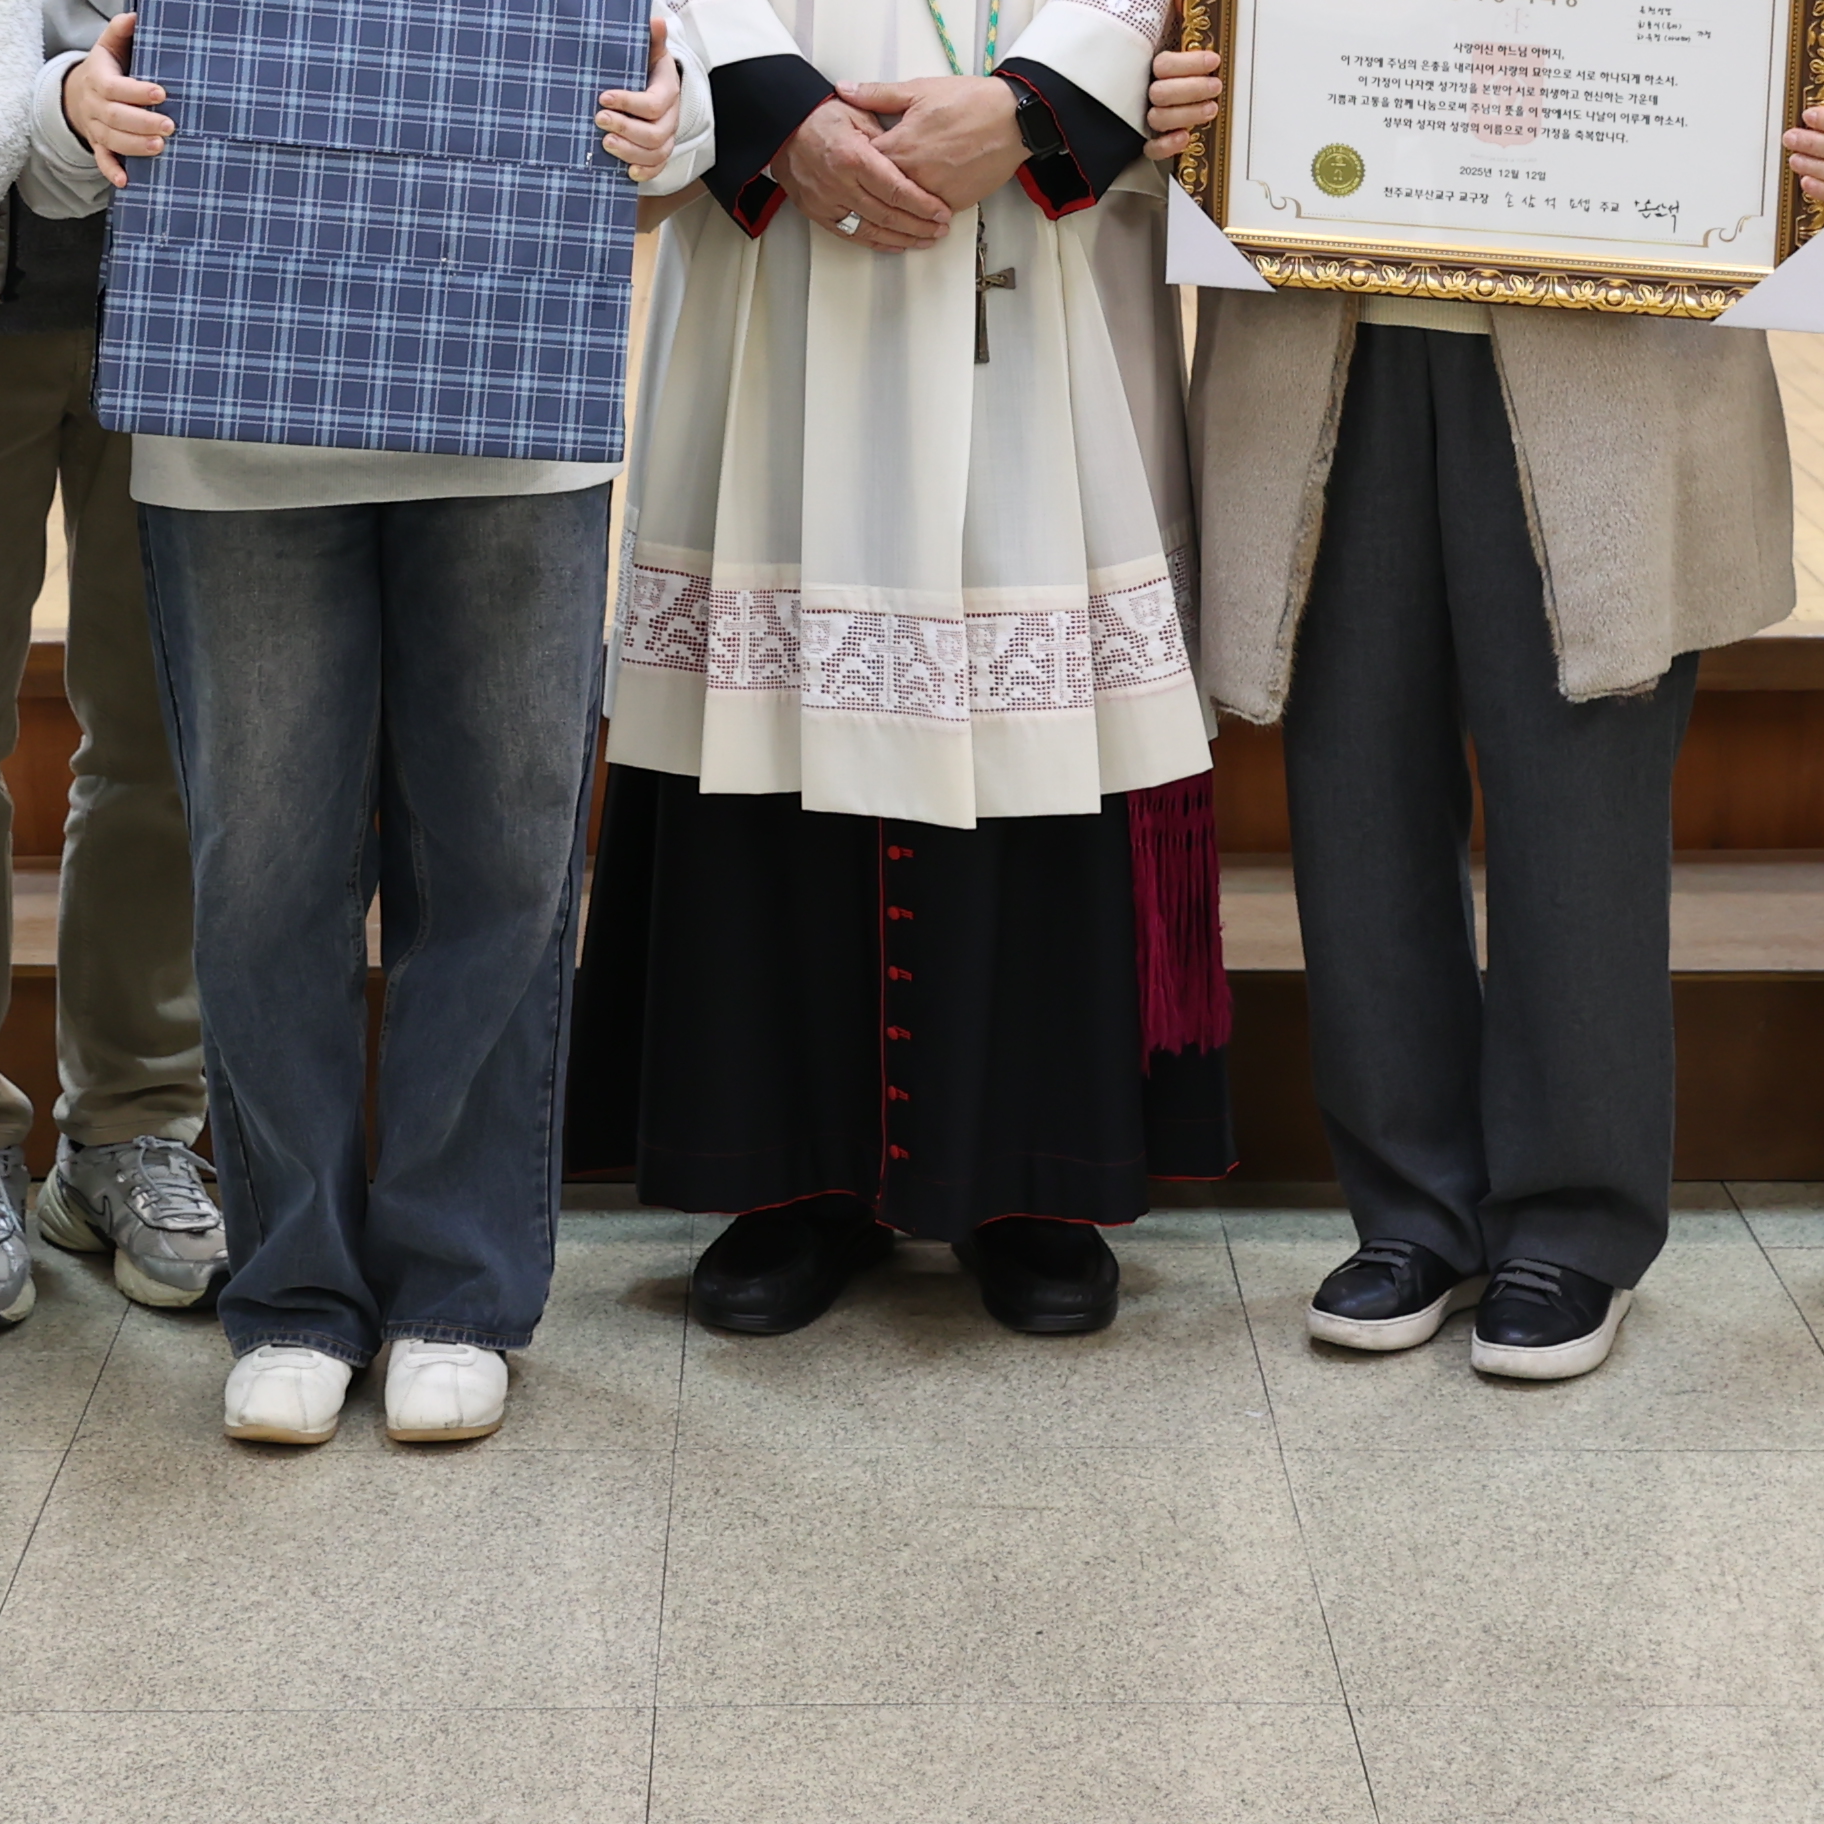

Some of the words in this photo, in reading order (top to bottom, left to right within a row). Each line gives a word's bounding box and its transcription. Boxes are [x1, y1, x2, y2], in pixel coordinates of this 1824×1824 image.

[1454, 42, 1494, 56] 사랑이신
[1498, 45, 1527, 58] 하느님
[1531, 47, 1565, 60] 아버지,
[1341, 55, 1350, 65] 이
[1354, 56, 1384, 68] 가정에
[1388, 58, 1416, 70] 주님의
[1420, 60, 1450, 72] 은총을
[1454, 62, 1494, 75] 내리시어
[1498, 65, 1528, 77] 사랑의
[1532, 66, 1572, 79] 묘약으로
[1576, 70, 1595, 81] 서로
[1600, 72, 1640, 84] 하나되게
[1644, 74, 1678, 86] 하소서.
[1358, 76, 1368, 86] 이
[1371, 76, 1401, 88] 가정이
[1405, 78, 1434, 91] 나자렛
[1438, 81, 1478, 94] 성가정을
[1482, 84, 1512, 96] 본받아
[1516, 86, 1535, 97] 서로
[1539, 88, 1579, 100] 희생하고
[1584, 90, 1624, 104] 헌신하는
[1628, 93, 1658, 106] 가운데
[1327, 93, 1357, 105] 기쁨과
[1361, 96, 1389, 108] 고통을
[1394, 98, 1413, 109] 함께
[1418, 99, 1467, 113] 나눔으로써
[1471, 103, 1501, 115] 주님의
[1505, 105, 1524, 116] 뜻을
[1528, 106, 1538, 117] 이
[1542, 107, 1582, 120] 땅에서도
[1586, 109, 1616, 123] 나날이
[1620, 112, 1650, 125] 이루게
[1655, 114, 1688, 127] 하소서.
[1383, 117, 1412, 129] 성부와
[1416, 118, 1446, 131] 성자와
[1450, 121, 1479, 134] 성령의
[1483, 124, 1523, 136] 이름으로
[1527, 126, 1537, 137] 이
[1541, 127, 1570, 140] 가정을
[1574, 130, 1628, 144] 축복합니다.
[1459, 166, 1492, 178] 2025년
[1498, 169, 1519, 180] 12월
[1526, 171, 1546, 181] 12일
[1384, 186, 1454, 202] 천주교부산교구
[1459, 192, 1489, 204] 교구장
[1600, 202, 1619, 213] 주교
